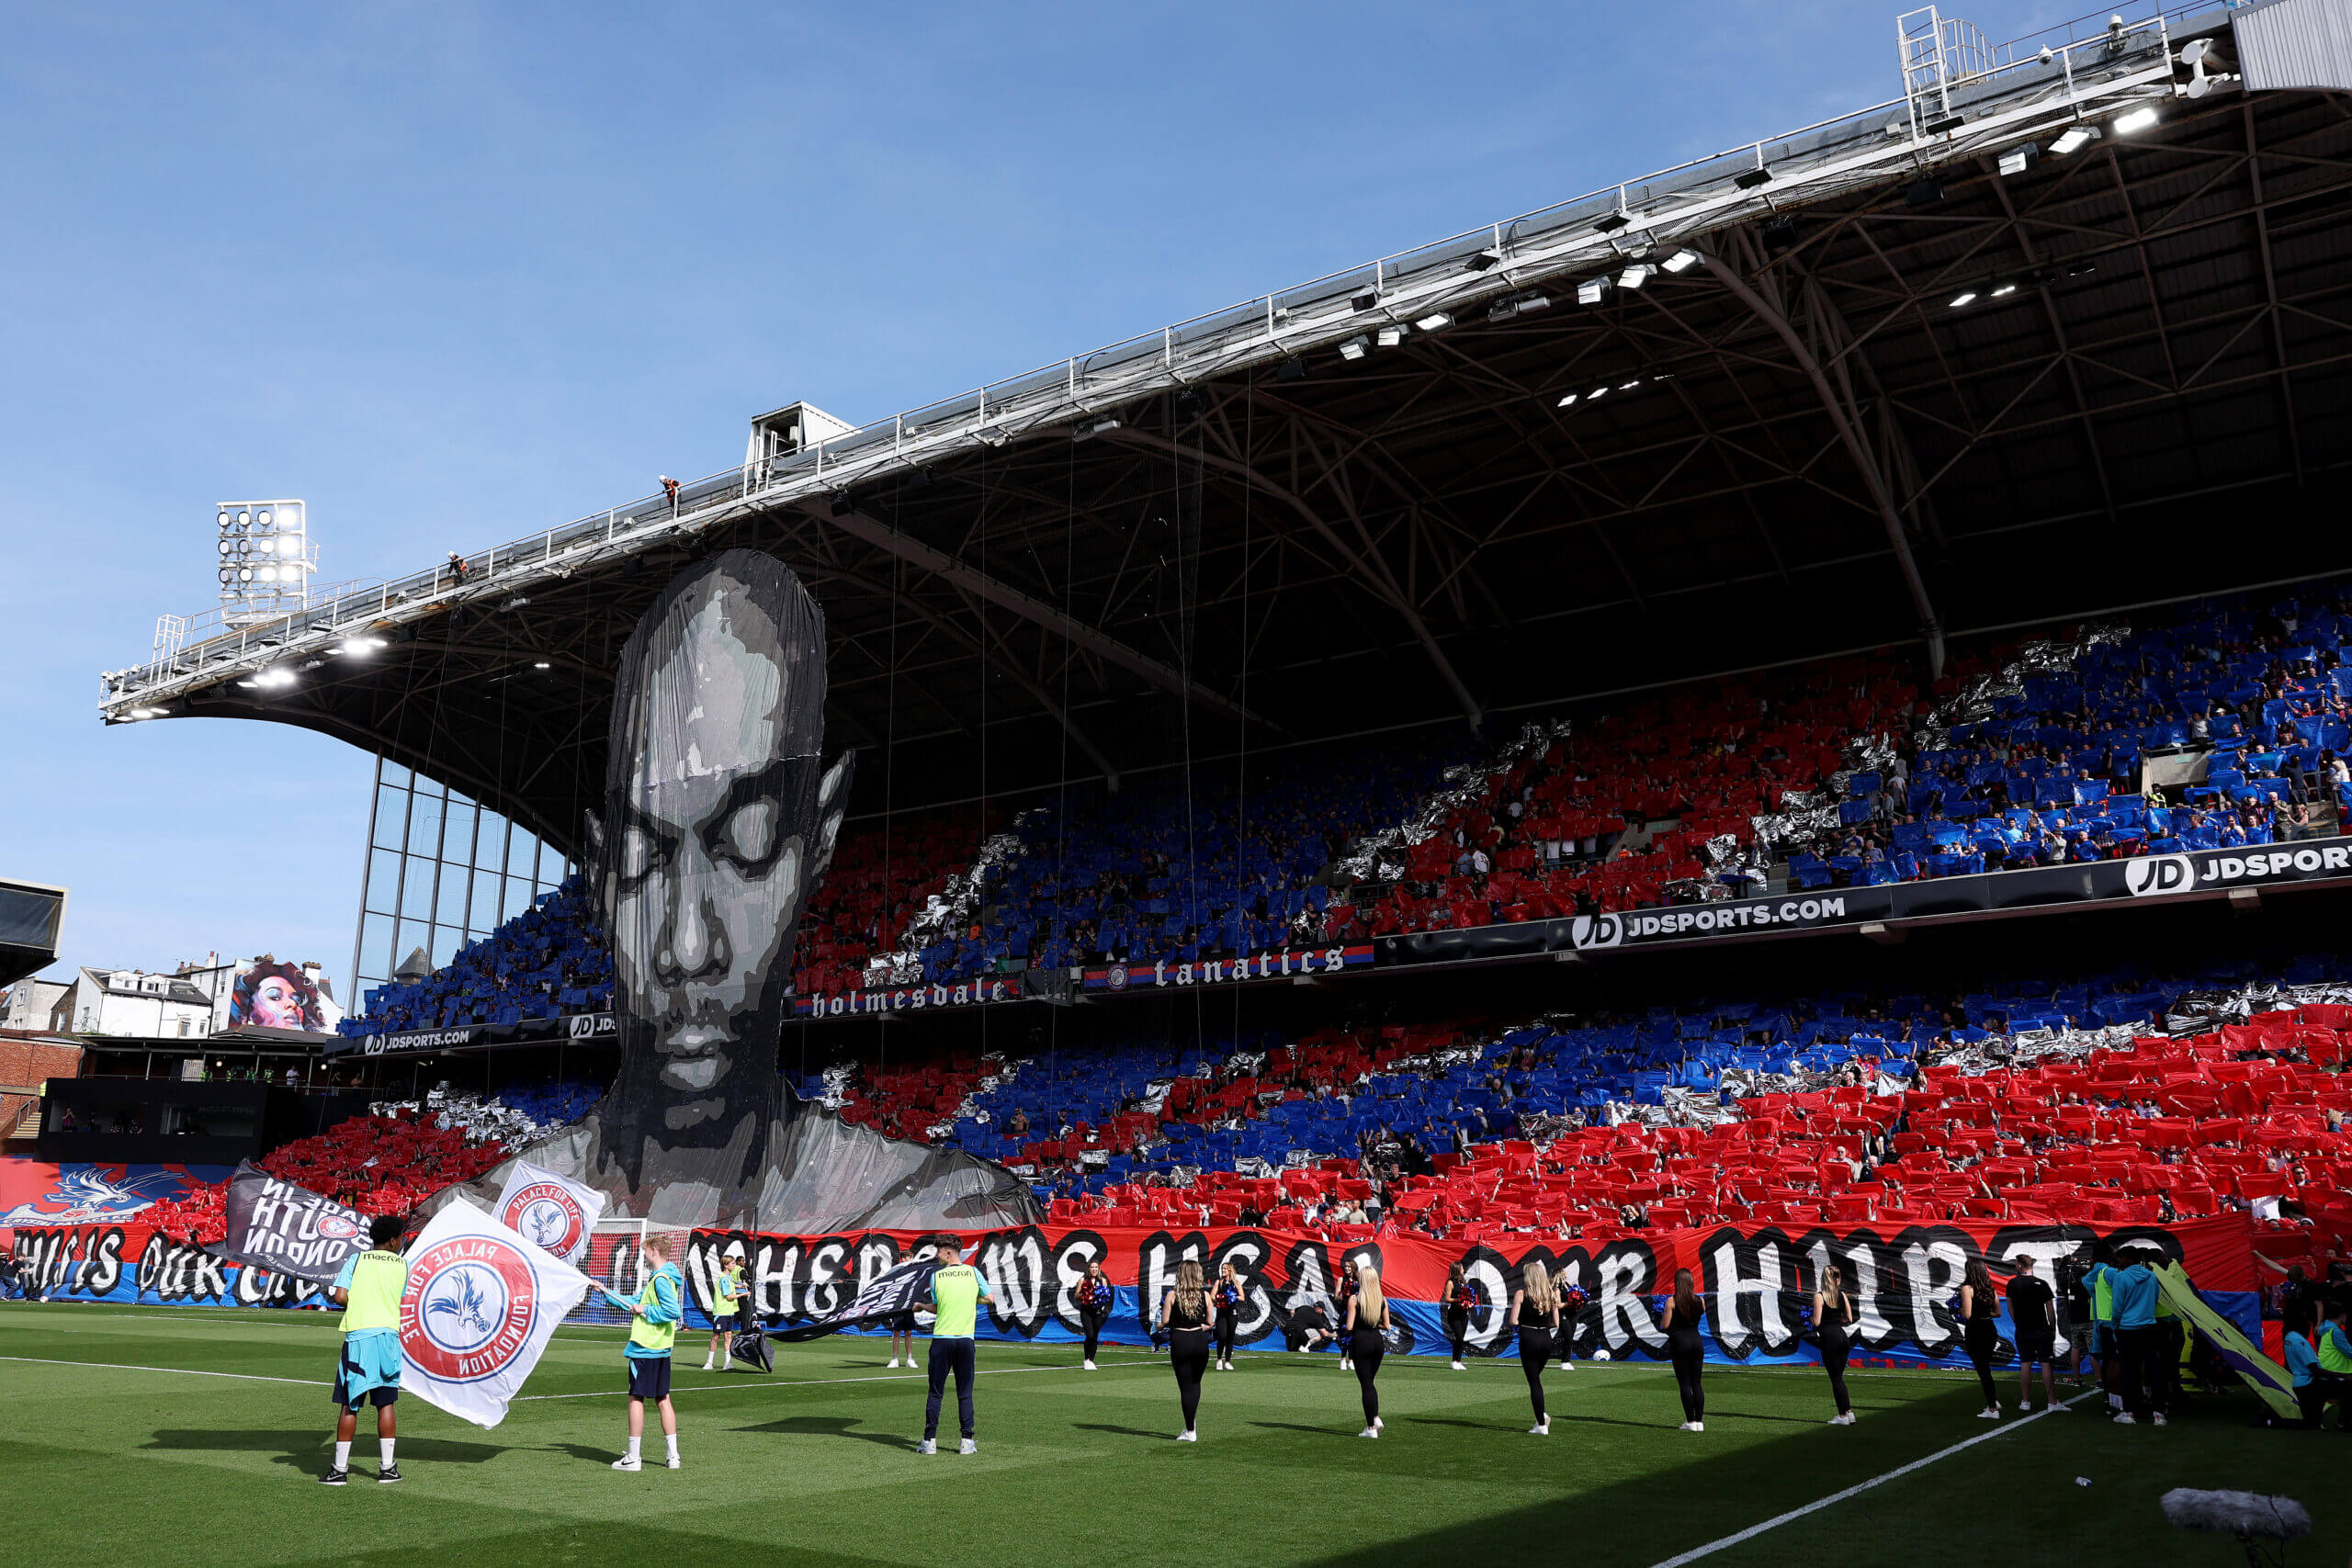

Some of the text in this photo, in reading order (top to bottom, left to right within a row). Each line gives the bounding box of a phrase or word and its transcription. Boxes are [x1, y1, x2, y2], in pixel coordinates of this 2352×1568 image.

[2200, 845, 2352, 881] JDSPOR
[1627, 897, 1846, 937] JDSPORTS.COM
[812, 976, 1005, 1019] holmesdale
[387, 1031, 469, 1049] JDSPORTS.COM
[513, 1186, 580, 1221] PALACE FOR LIFE
[363, 1253, 404, 1265] macron
[938, 1270, 972, 1279] macron
[980, 1234, 1099, 1326] WE
